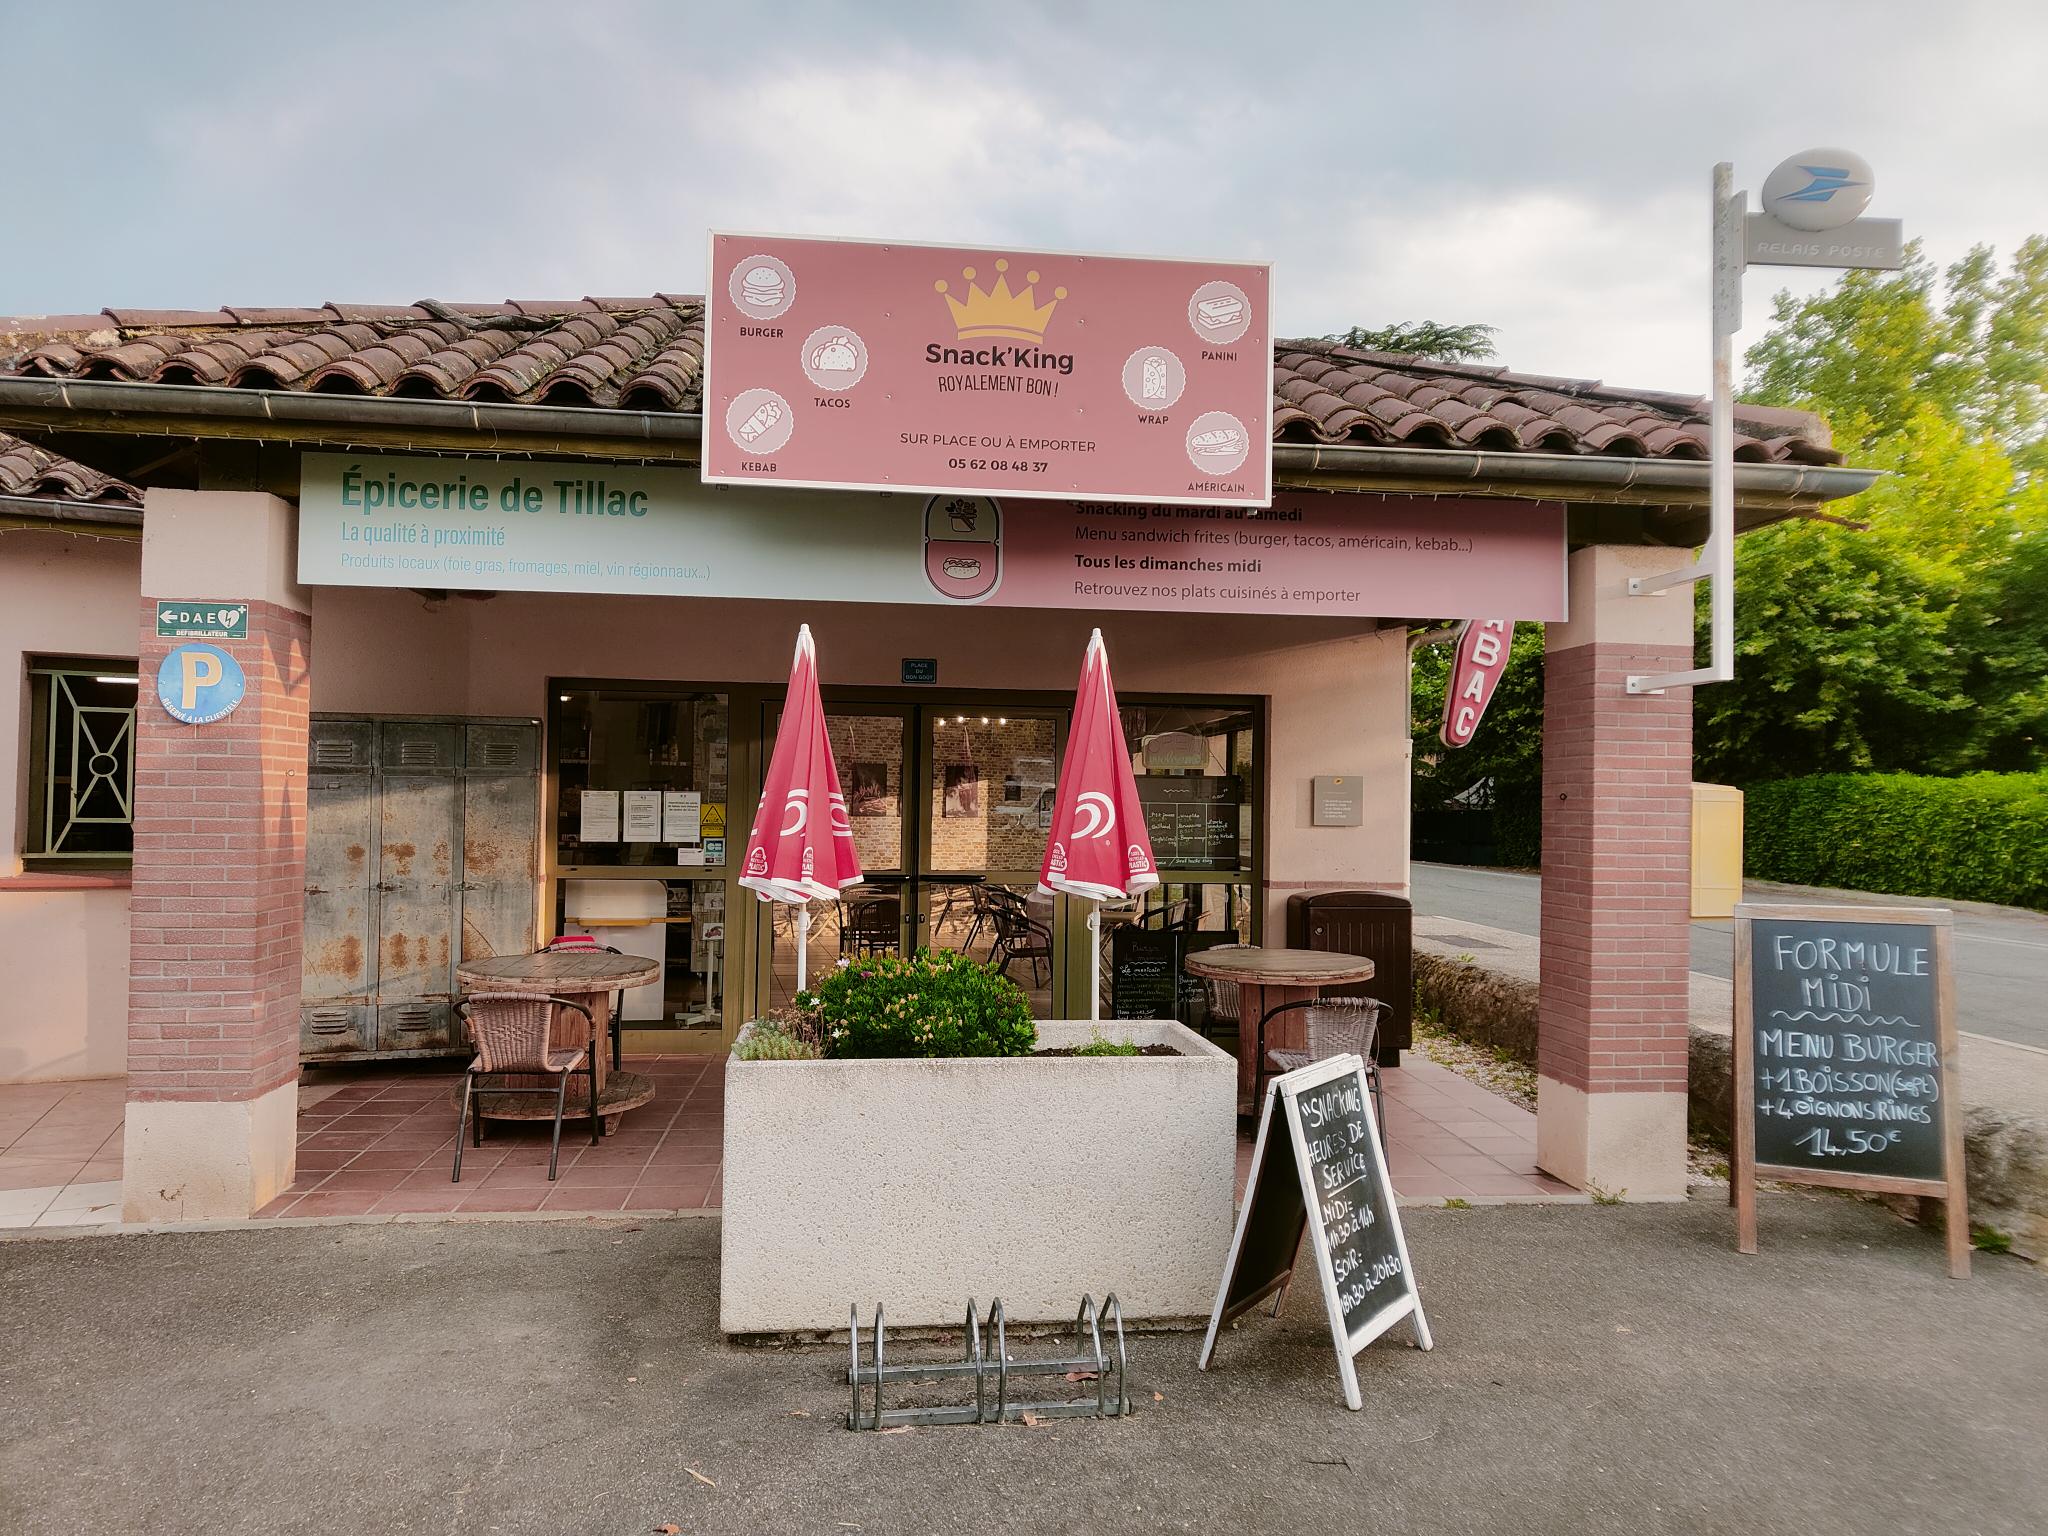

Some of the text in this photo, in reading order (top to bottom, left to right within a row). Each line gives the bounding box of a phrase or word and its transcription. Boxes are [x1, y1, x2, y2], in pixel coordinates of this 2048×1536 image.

[1757, 241, 1887, 258] RELAIS POSTE
[740, 326, 784, 338] BURGER
[925, 343, 1074, 375] Snack'King
[1201, 350, 1237, 362] PANINI
[938, 374, 1023, 393] ROYALEMENT
[814, 397, 851, 409] TACOS
[1138, 414, 1169, 425] WRAP
[900, 432, 1096, 453] SUR PLACE OU À EMPORTER
[741, 461, 777, 473] KEBAB
[948, 458, 1049, 473] 05 62 08 48 37
[342, 464, 649, 517] Épicerie de Tillac
[1187, 480, 1245, 493] AMÉRICAIN
[1075, 501, 1148, 520] Snacking
[1151, 503, 1172, 518] du
[1175, 505, 1222, 520] mardi
[1224, 507, 1244, 520] au
[342, 521, 505, 549] La qualité à proximité
[1075, 525, 1474, 553] Menu sandwich frites (burger, tacos, américain, kebab...)
[341, 552, 394, 569] Produits
[398, 554, 440, 570] locaux
[443, 555, 471, 577] (foie
[475, 558, 505, 575] gras,
[508, 558, 570, 577] fromages,
[574, 561, 603, 577] miel,
[606, 562, 626, 577] vin
[1074, 554, 1262, 573] Tous les dimanches midi
[1074, 581, 1361, 603] Retrouvez nos plats cuisinés à emporter
[181, 652, 223, 710] P
[194, 715, 204, 723] LA
[1775, 935, 1929, 977] FORMULE
[1759, 1028, 1940, 1068] MENU BURGER
[1307, 1120, 1365, 1168] HEURES DE
[1373, 1254, 1402, 1286] 20h30
